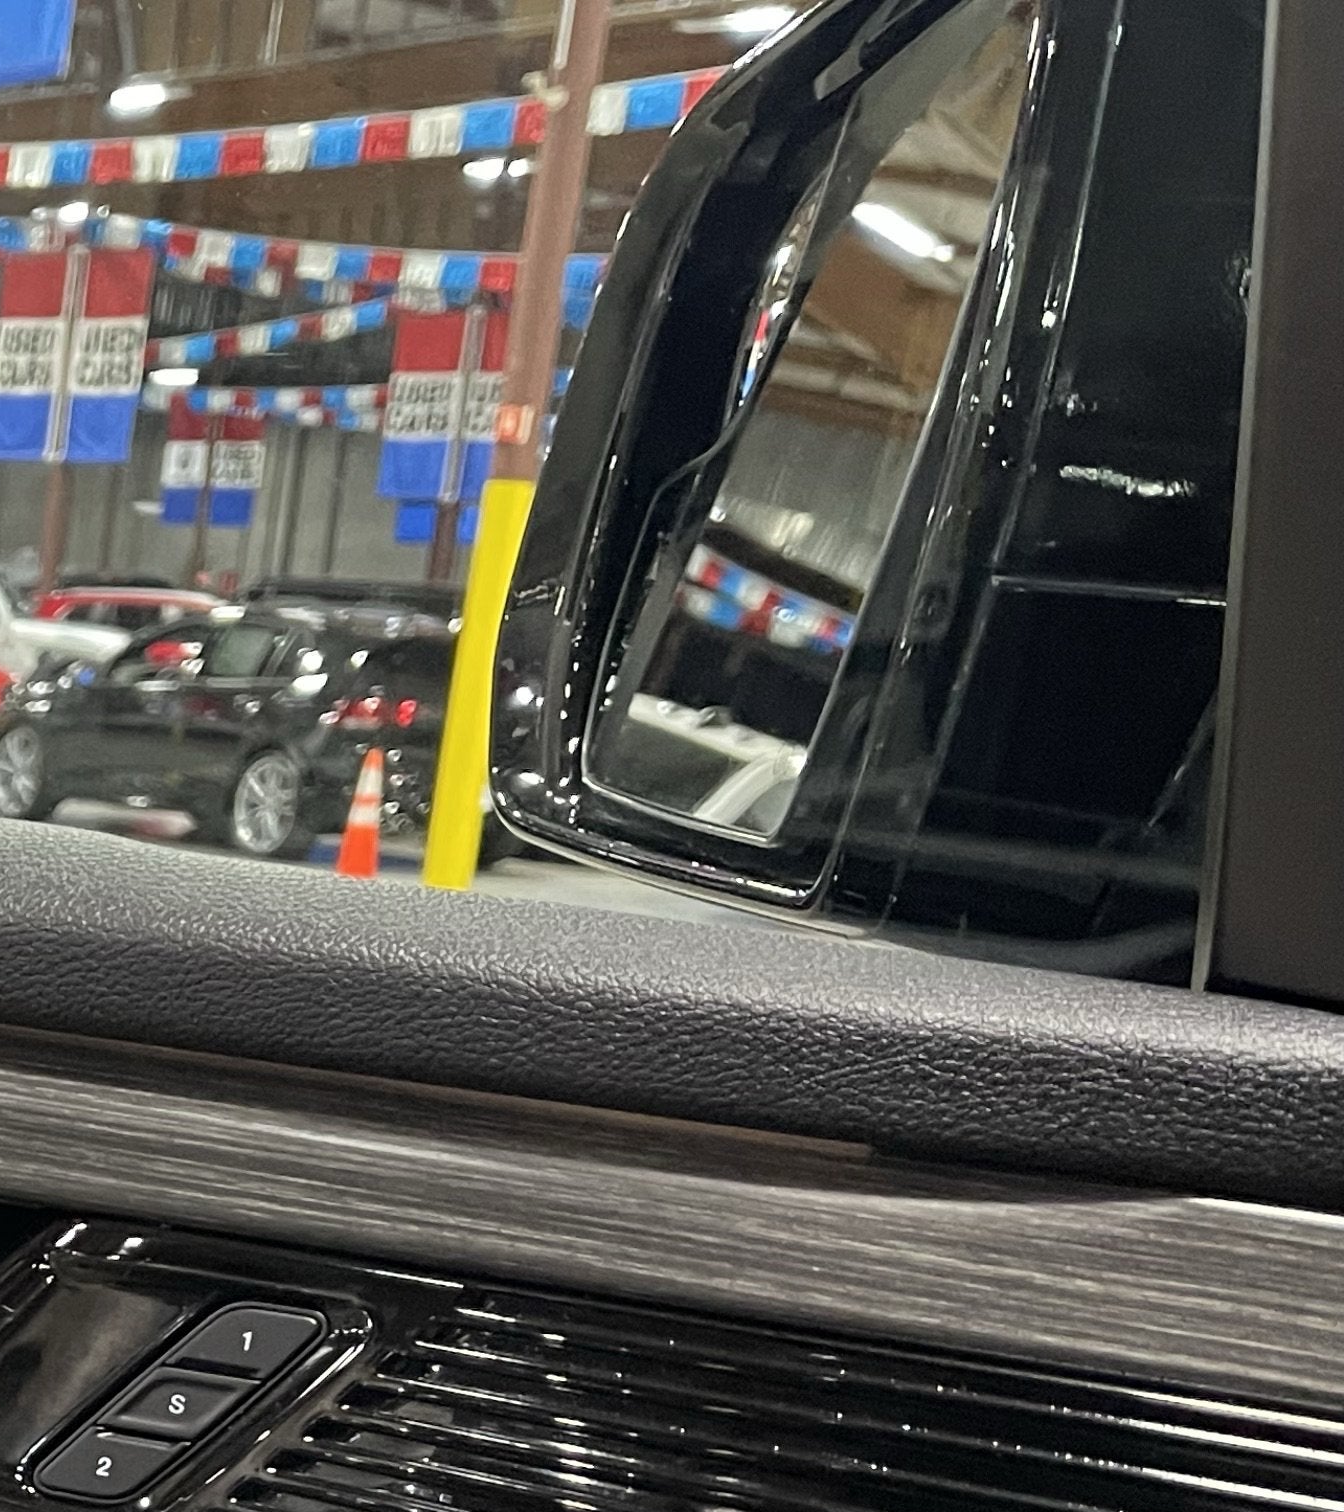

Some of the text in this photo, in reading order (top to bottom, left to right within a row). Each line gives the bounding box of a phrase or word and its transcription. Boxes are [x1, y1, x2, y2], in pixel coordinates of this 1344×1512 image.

[240, 1330, 254, 1352] 1
[167, 1393, 188, 1416] S
[94, 1456, 112, 1478] 2
